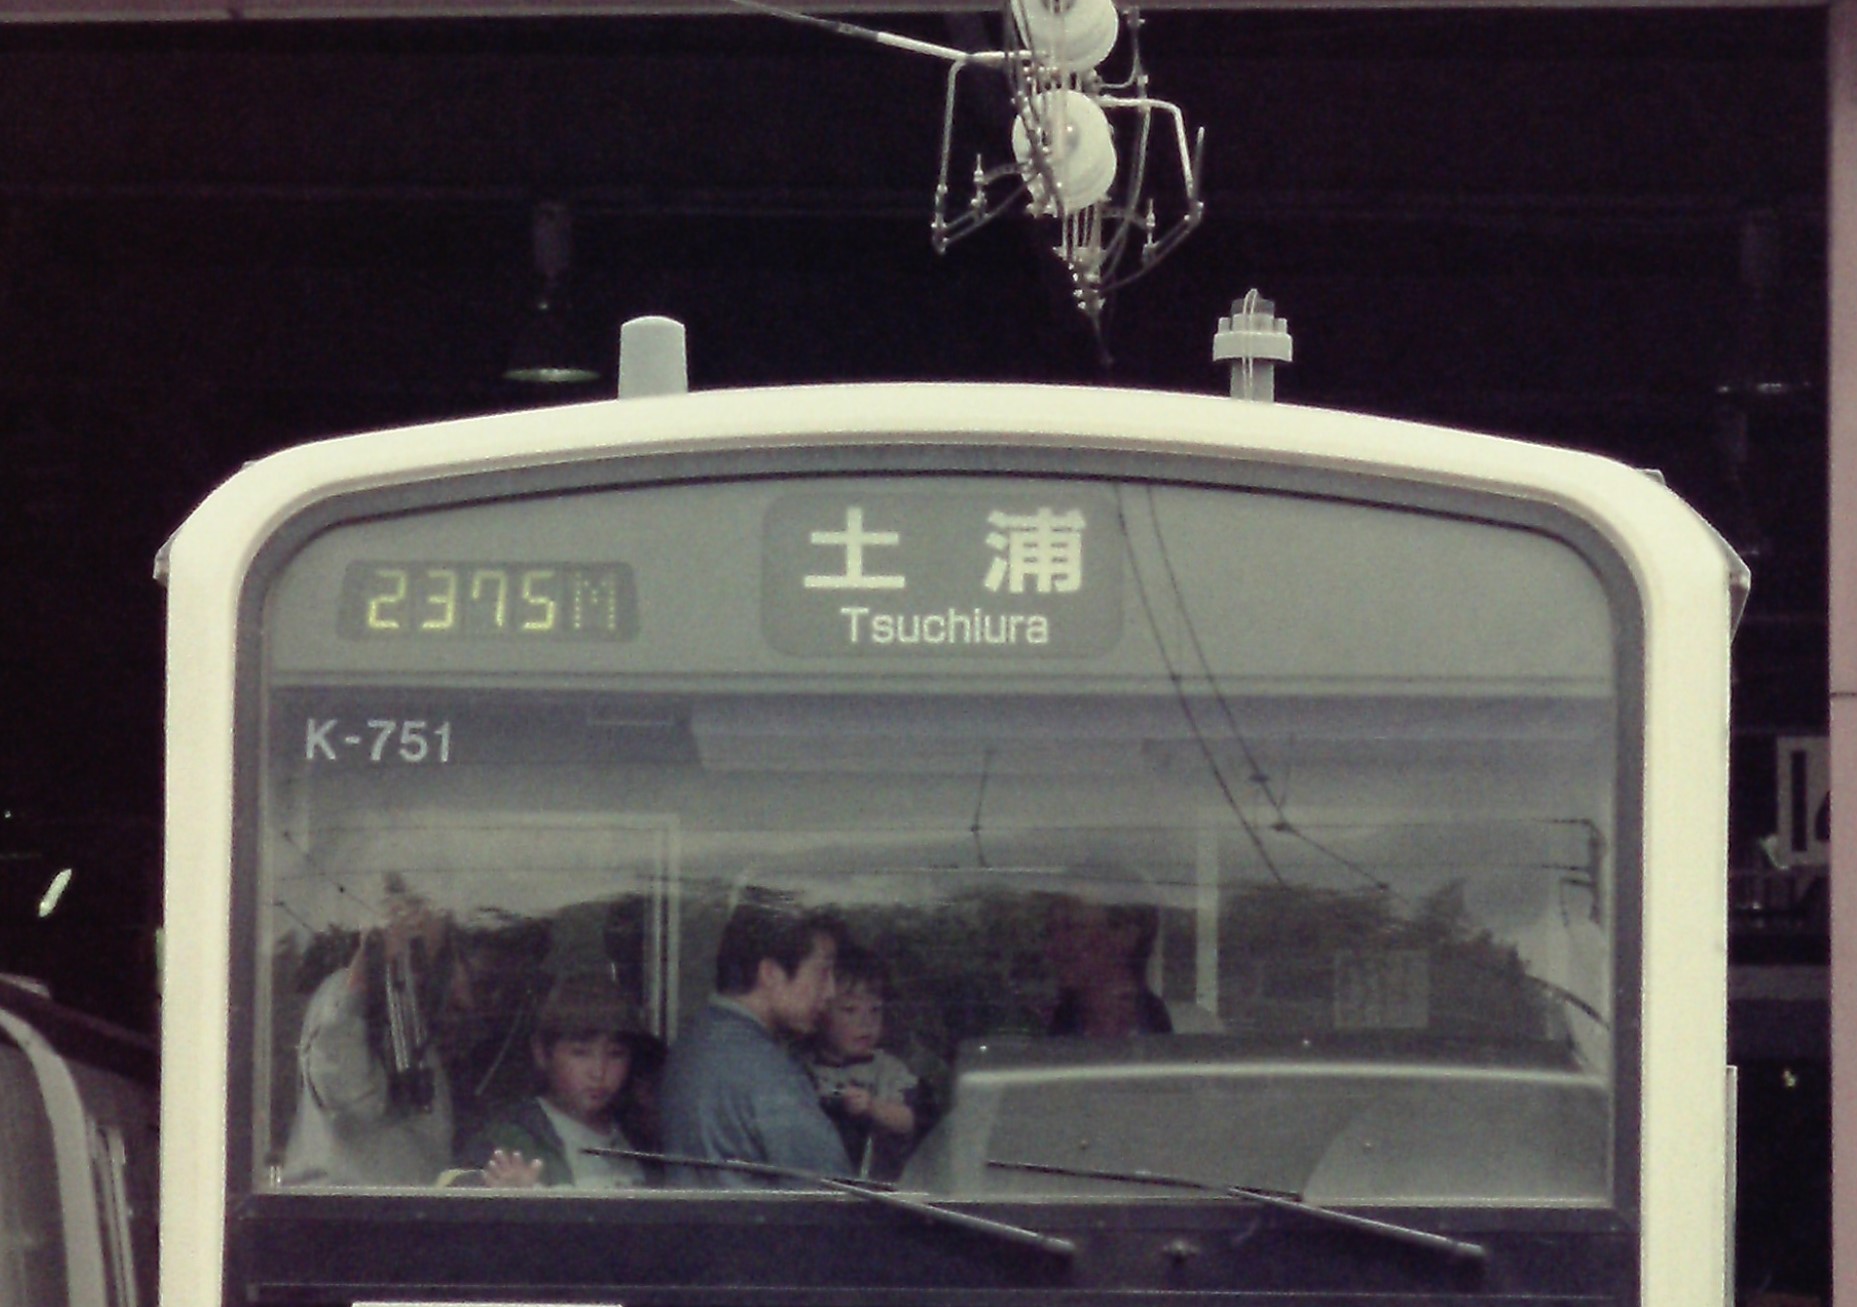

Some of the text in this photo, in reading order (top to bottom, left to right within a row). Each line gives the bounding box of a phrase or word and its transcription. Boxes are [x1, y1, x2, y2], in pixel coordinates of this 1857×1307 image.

[804, 507, 1086, 593] 土浦
[840, 607, 1048, 644] Tsuchiura
[305, 718, 451, 762] K-751
